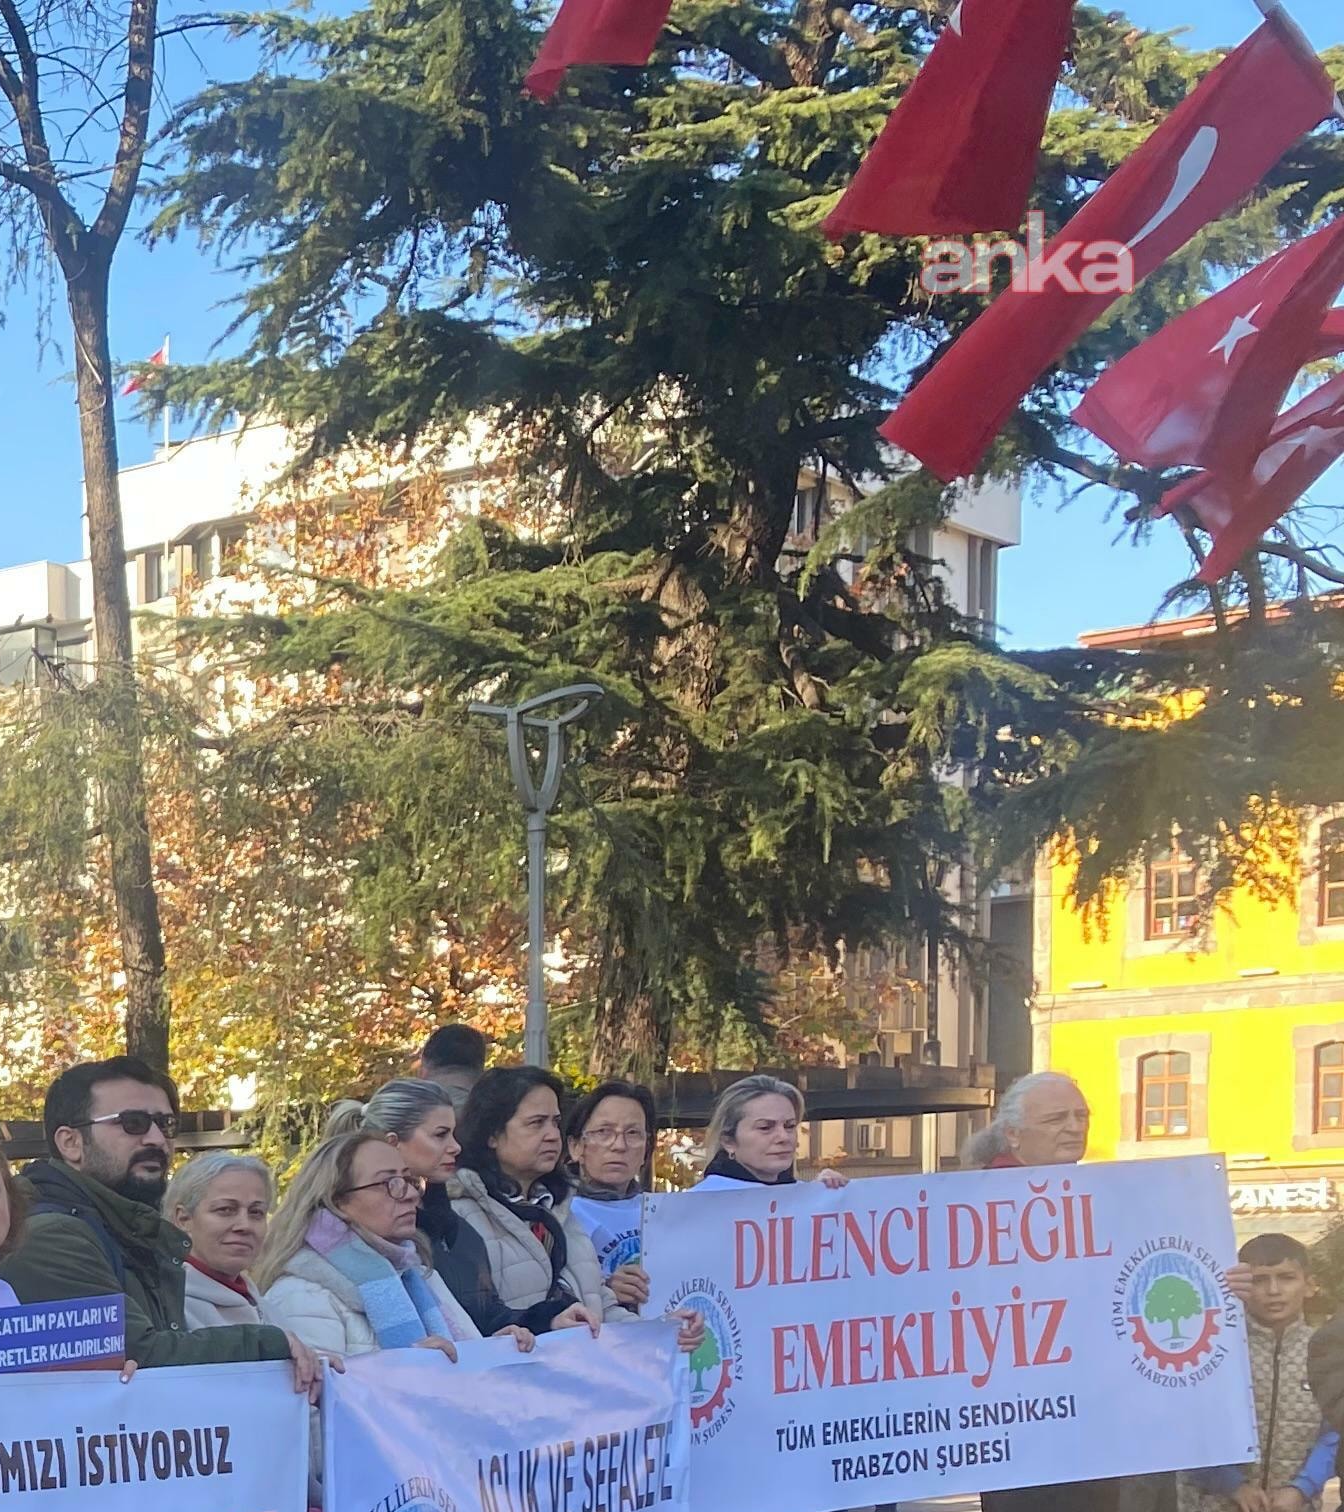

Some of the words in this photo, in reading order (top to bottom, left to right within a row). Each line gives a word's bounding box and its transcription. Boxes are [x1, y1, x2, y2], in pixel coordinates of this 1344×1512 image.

[734, 1189, 931, 1290] DİLENCİ
[948, 1179, 1113, 1271] DEĞİL
[48, 1307, 102, 1331] PAYLARI
[103, 1305, 118, 1323] VE
[772, 1285, 1072, 1395] EMEKLİYİZ
[776, 1419, 816, 1453] TÜM
[822, 1402, 951, 1447] EMEKLİLERİN
[958, 1394, 1077, 1431] SENDİKASI
[76, 1423, 233, 1489] İSTİYORUZ
[832, 1447, 929, 1483] TRABZON
[936, 1430, 1011, 1477] ŞUBESİ
